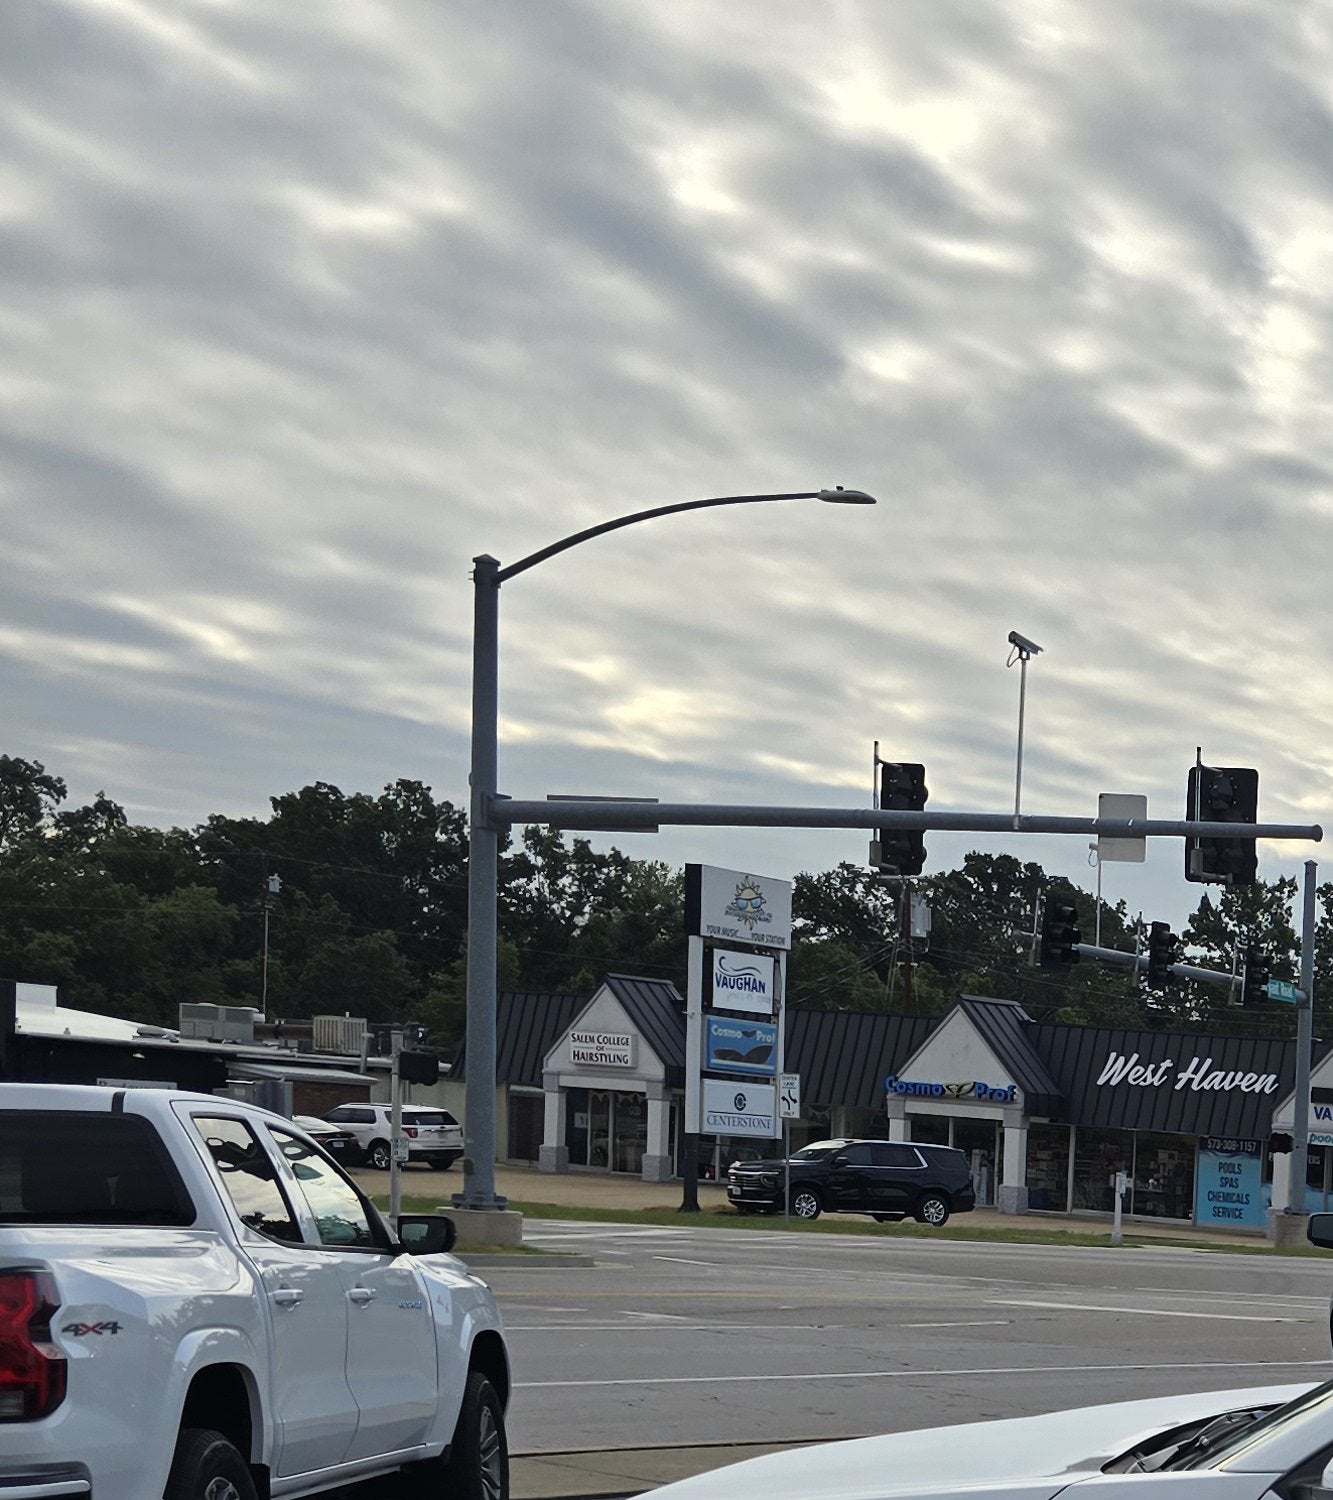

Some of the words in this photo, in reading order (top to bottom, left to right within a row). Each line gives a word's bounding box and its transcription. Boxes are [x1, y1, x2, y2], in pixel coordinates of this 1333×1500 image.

[715, 972, 766, 993] VAUGHAN
[571, 1032, 595, 1043] SALEM
[596, 1034, 630, 1046] COLLEGE
[711, 1024, 743, 1039] Cosmo
[573, 1050, 629, 1064] HAIRSTYLING
[1096, 1052, 1174, 1087] West
[1174, 1056, 1279, 1095] Haven
[885, 1075, 945, 1096] Cosmo
[974, 1082, 1017, 1101] Prof
[707, 1114, 772, 1129] CENTERSTONE
[1218, 1161, 1242, 1175] POOLS
[1219, 1176, 1239, 1189] SPAS
[1207, 1190, 1250, 1205] CHEMICALS
[1212, 1206, 1244, 1219] SERVICE
